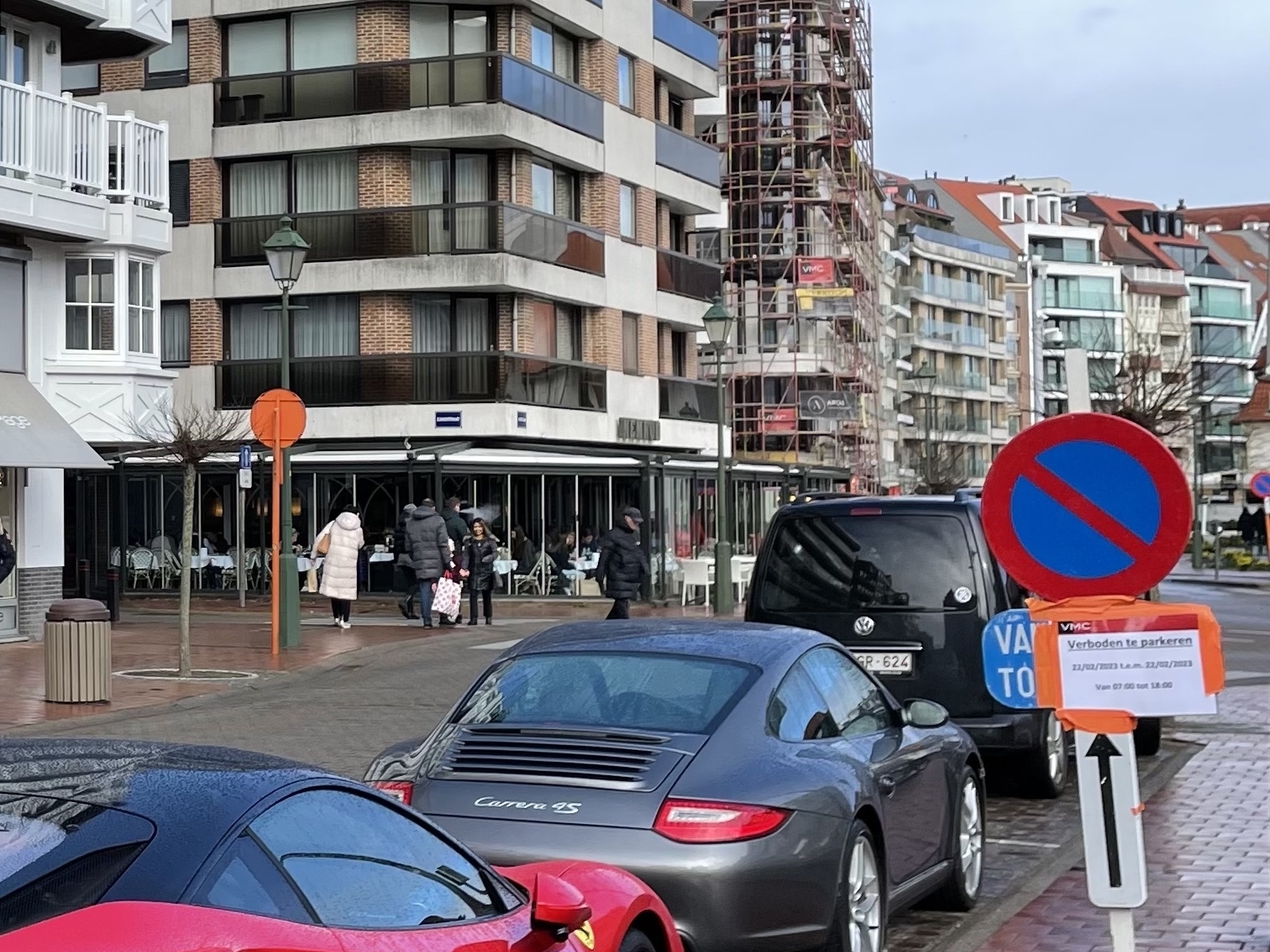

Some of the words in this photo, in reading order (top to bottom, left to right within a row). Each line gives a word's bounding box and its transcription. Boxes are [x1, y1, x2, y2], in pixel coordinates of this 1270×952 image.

[1060, 622, 1091, 631] VMC
[993, 622, 1036, 656] VA
[1067, 638, 1123, 650] Verboden
[1126, 638, 1138, 648] te
[1141, 636, 1193, 648] parkeren
[856, 655, 909, 669] GR-624
[1095, 683, 1111, 691] Van
[1136, 682, 1149, 690] tot
[474, 796, 547, 810] Carrera
[551, 801, 582, 814] 4S
